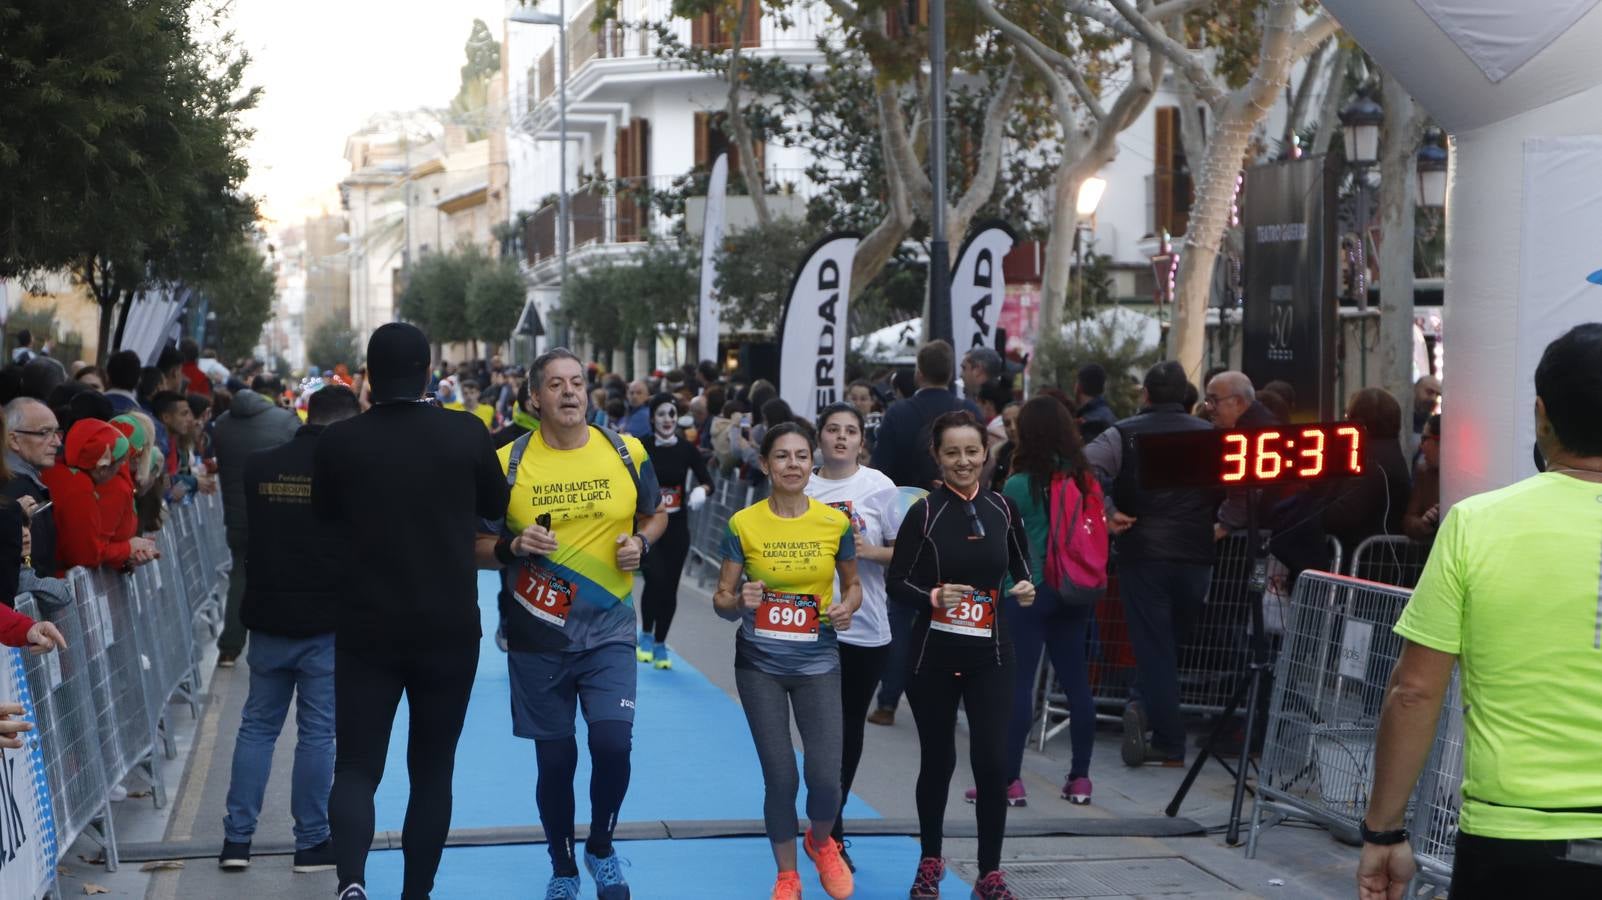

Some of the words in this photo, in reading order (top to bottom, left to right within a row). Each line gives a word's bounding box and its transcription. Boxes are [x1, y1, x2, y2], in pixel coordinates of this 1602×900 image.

[815, 258, 840, 420] ERDAD
[1222, 427, 1361, 481] 36:37
[533, 485, 542, 494] VI
[544, 483, 563, 494] SAN
[564, 479, 610, 492] SILVESTRE
[532, 495, 565, 506] CIUDAD
[567, 494, 578, 503] DE
[580, 490, 611, 502] LORCA
[763, 541, 771, 549] VI
[772, 541, 787, 550] SAN
[787, 541, 822, 550] SILVESTRE
[763, 550, 788, 558] CIUDAD
[789, 550, 798, 558] DE
[800, 550, 822, 558] LORCA
[525, 576, 558, 607] 715
[794, 599, 817, 608] LORCA
[945, 601, 984, 621] 230
[768, 605, 807, 627] 690
